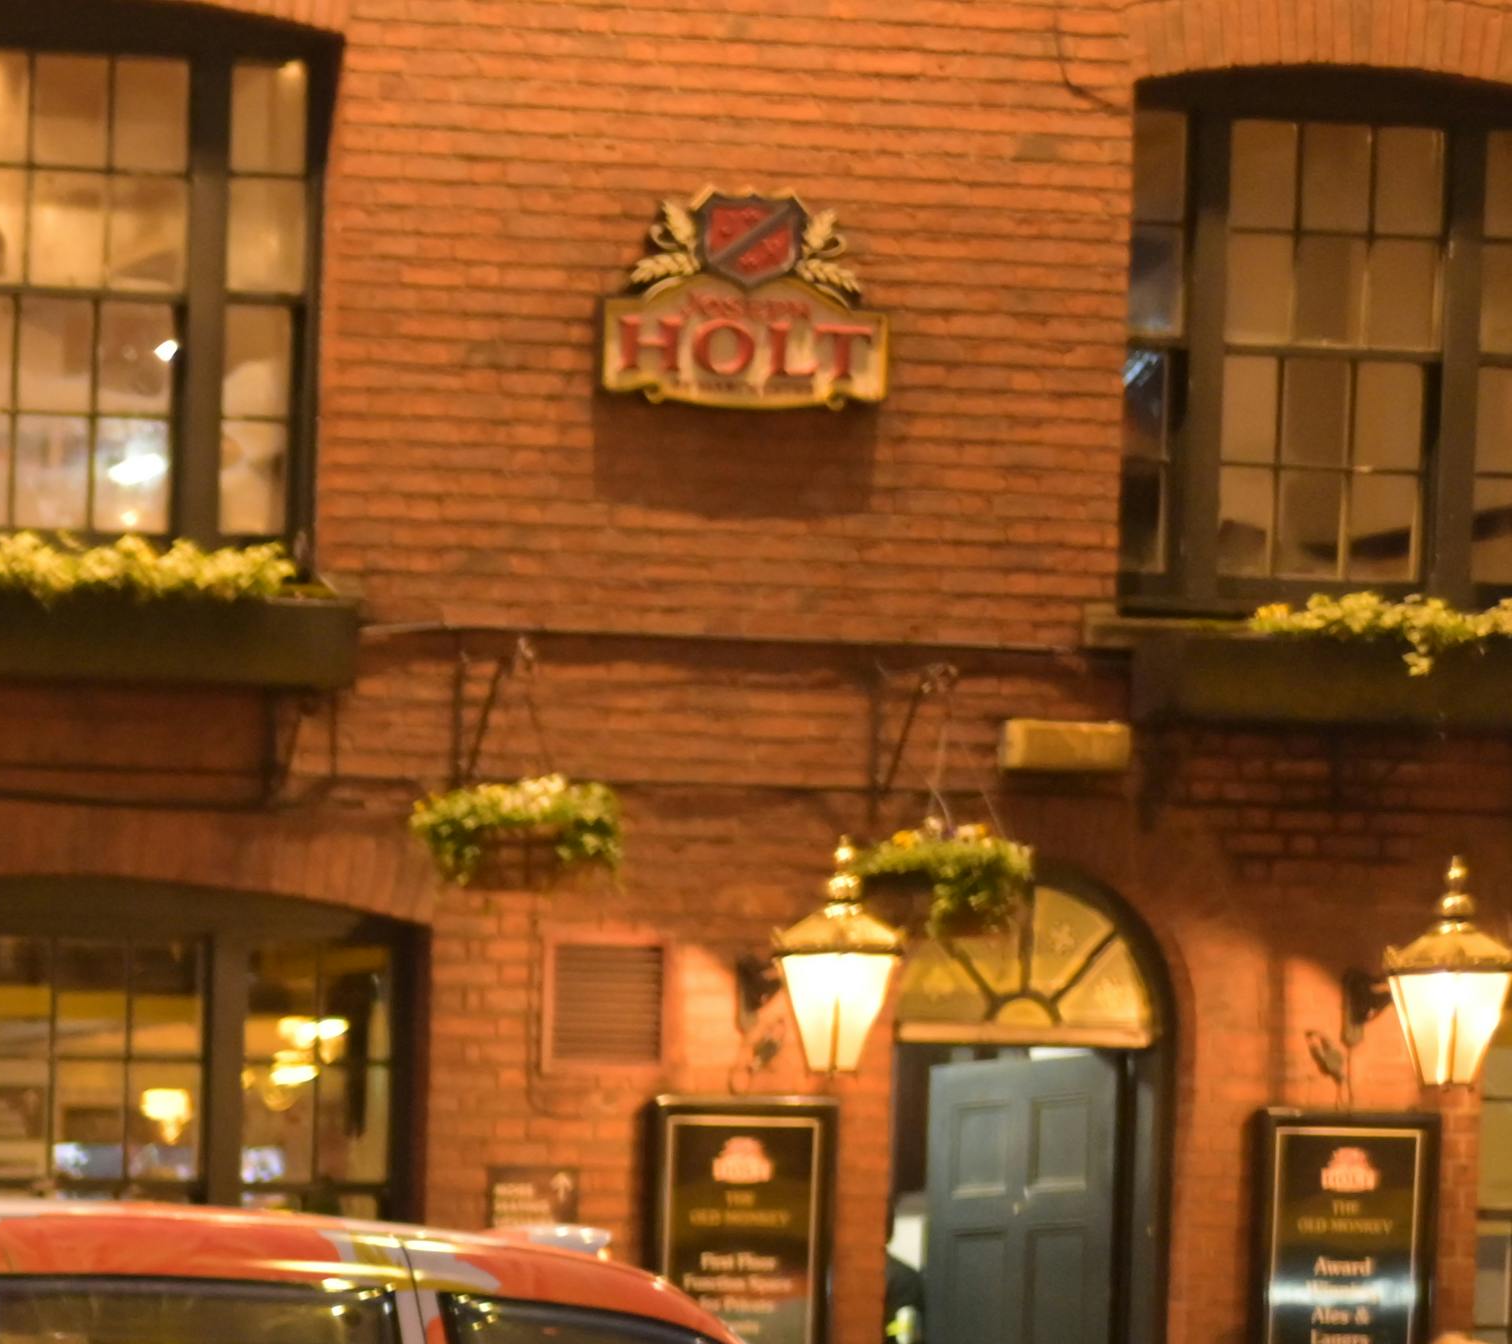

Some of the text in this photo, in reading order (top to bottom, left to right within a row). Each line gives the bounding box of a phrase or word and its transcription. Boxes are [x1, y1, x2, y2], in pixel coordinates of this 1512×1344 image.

[619, 314, 873, 378] HOLT
[1314, 1255, 1375, 1277] Award
[1311, 1305, 1371, 1326] Ales &
